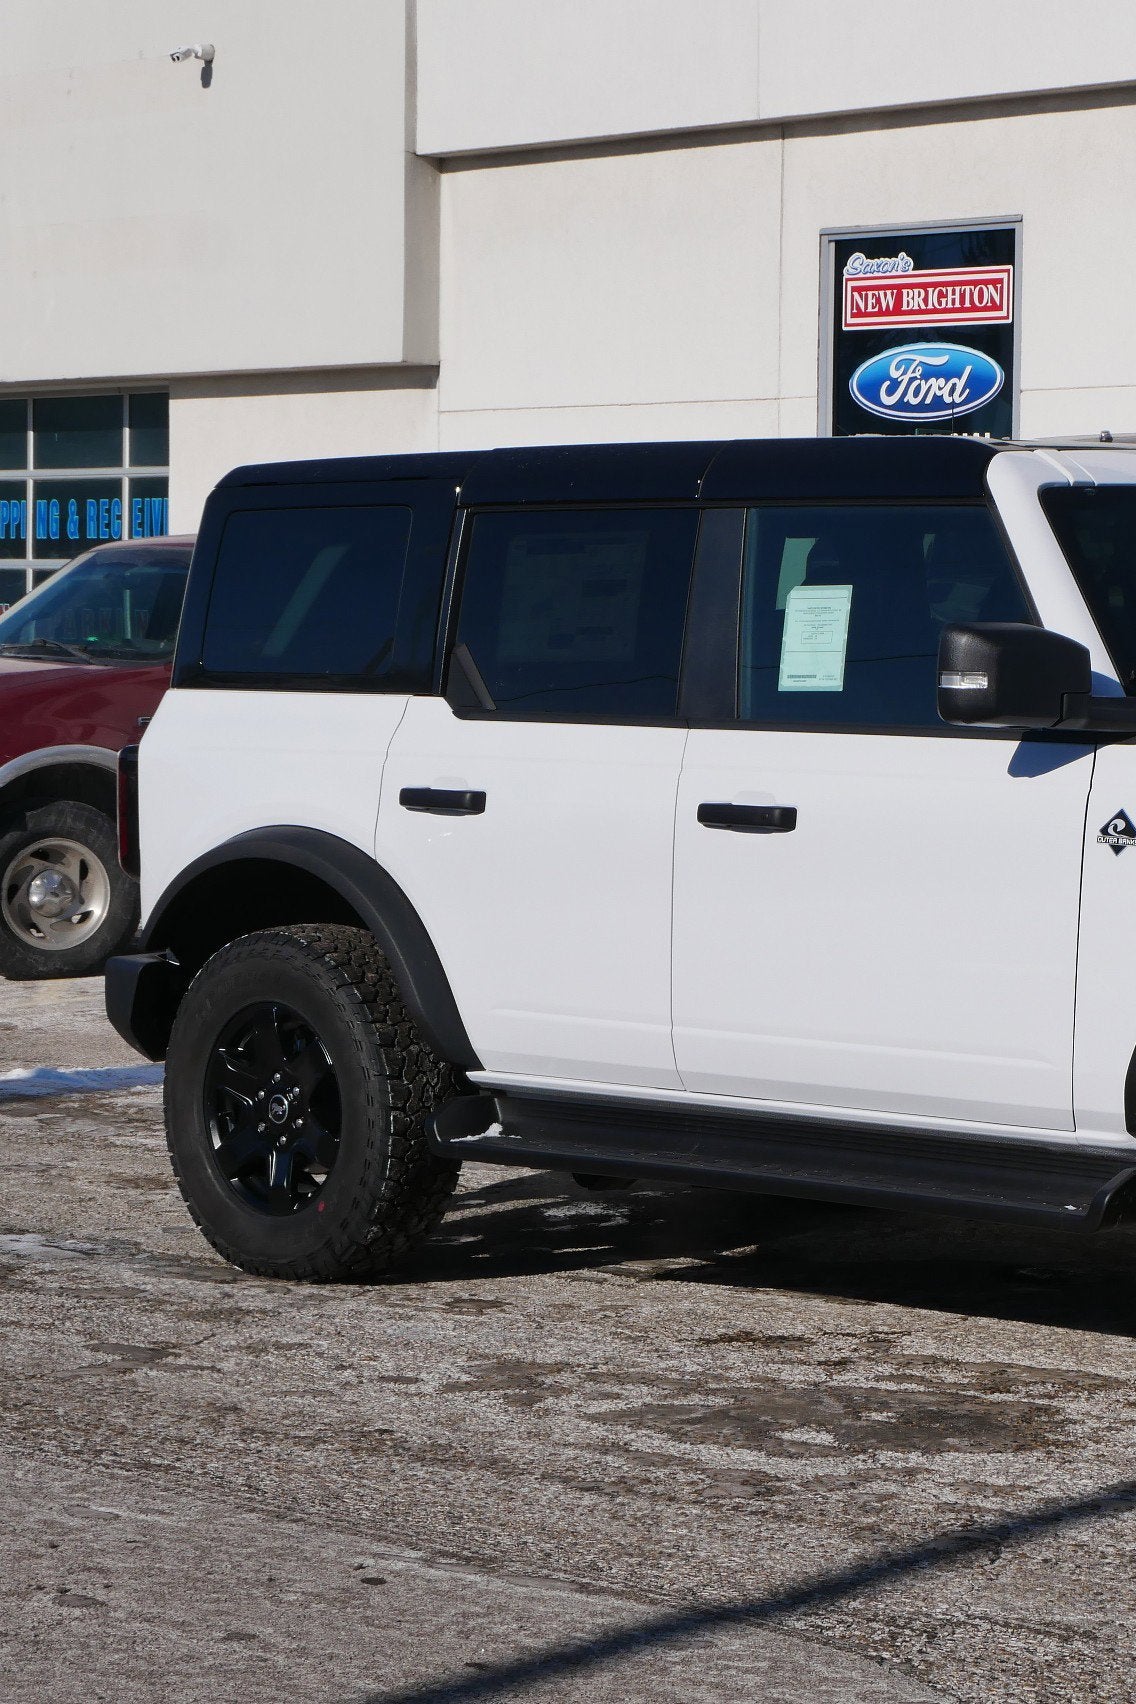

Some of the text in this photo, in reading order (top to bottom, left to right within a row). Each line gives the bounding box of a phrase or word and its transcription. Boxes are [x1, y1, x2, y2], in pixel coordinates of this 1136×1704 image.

[845, 252, 912, 276] Saxon's
[851, 283, 1002, 314] NEW BRIGHTON
[879, 354, 973, 406] Ford
[67, 499, 80, 540] &
